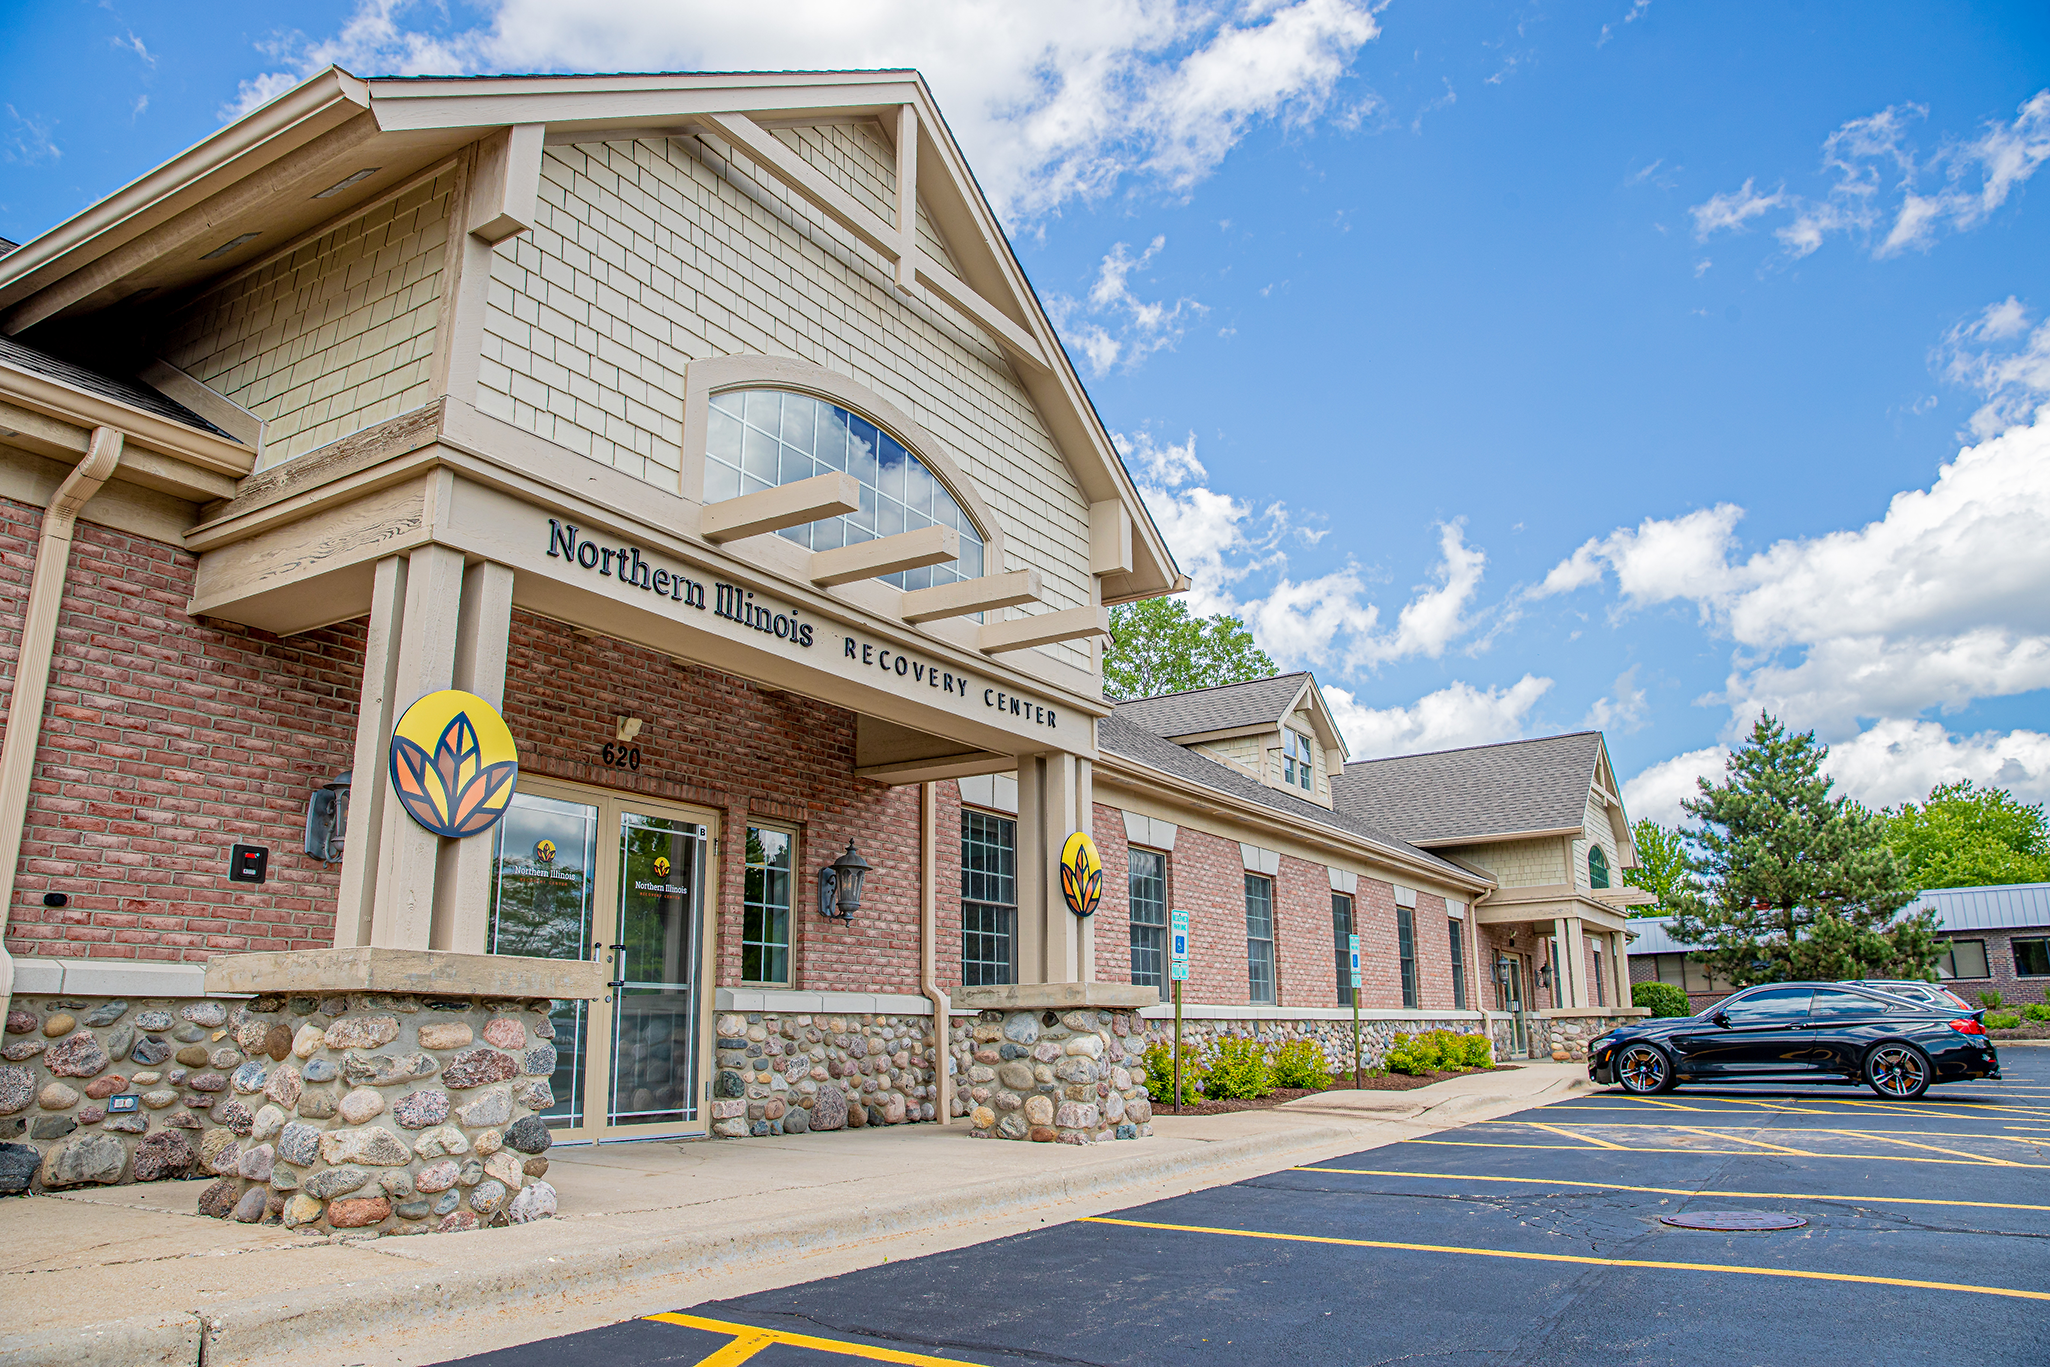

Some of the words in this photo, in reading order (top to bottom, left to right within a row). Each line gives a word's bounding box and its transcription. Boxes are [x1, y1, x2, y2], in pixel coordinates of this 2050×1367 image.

[547, 519, 706, 610] Northern
[714, 582, 814, 647] Illinois
[844, 637, 967, 697] RECOVERY
[984, 689, 1057, 728] CENTER
[602, 742, 641, 770] 620
[515, 866, 549, 877] Northern
[550, 870, 576, 880] Illinois
[635, 881, 664, 892] Northern
[665, 884, 687, 894] Illinois
